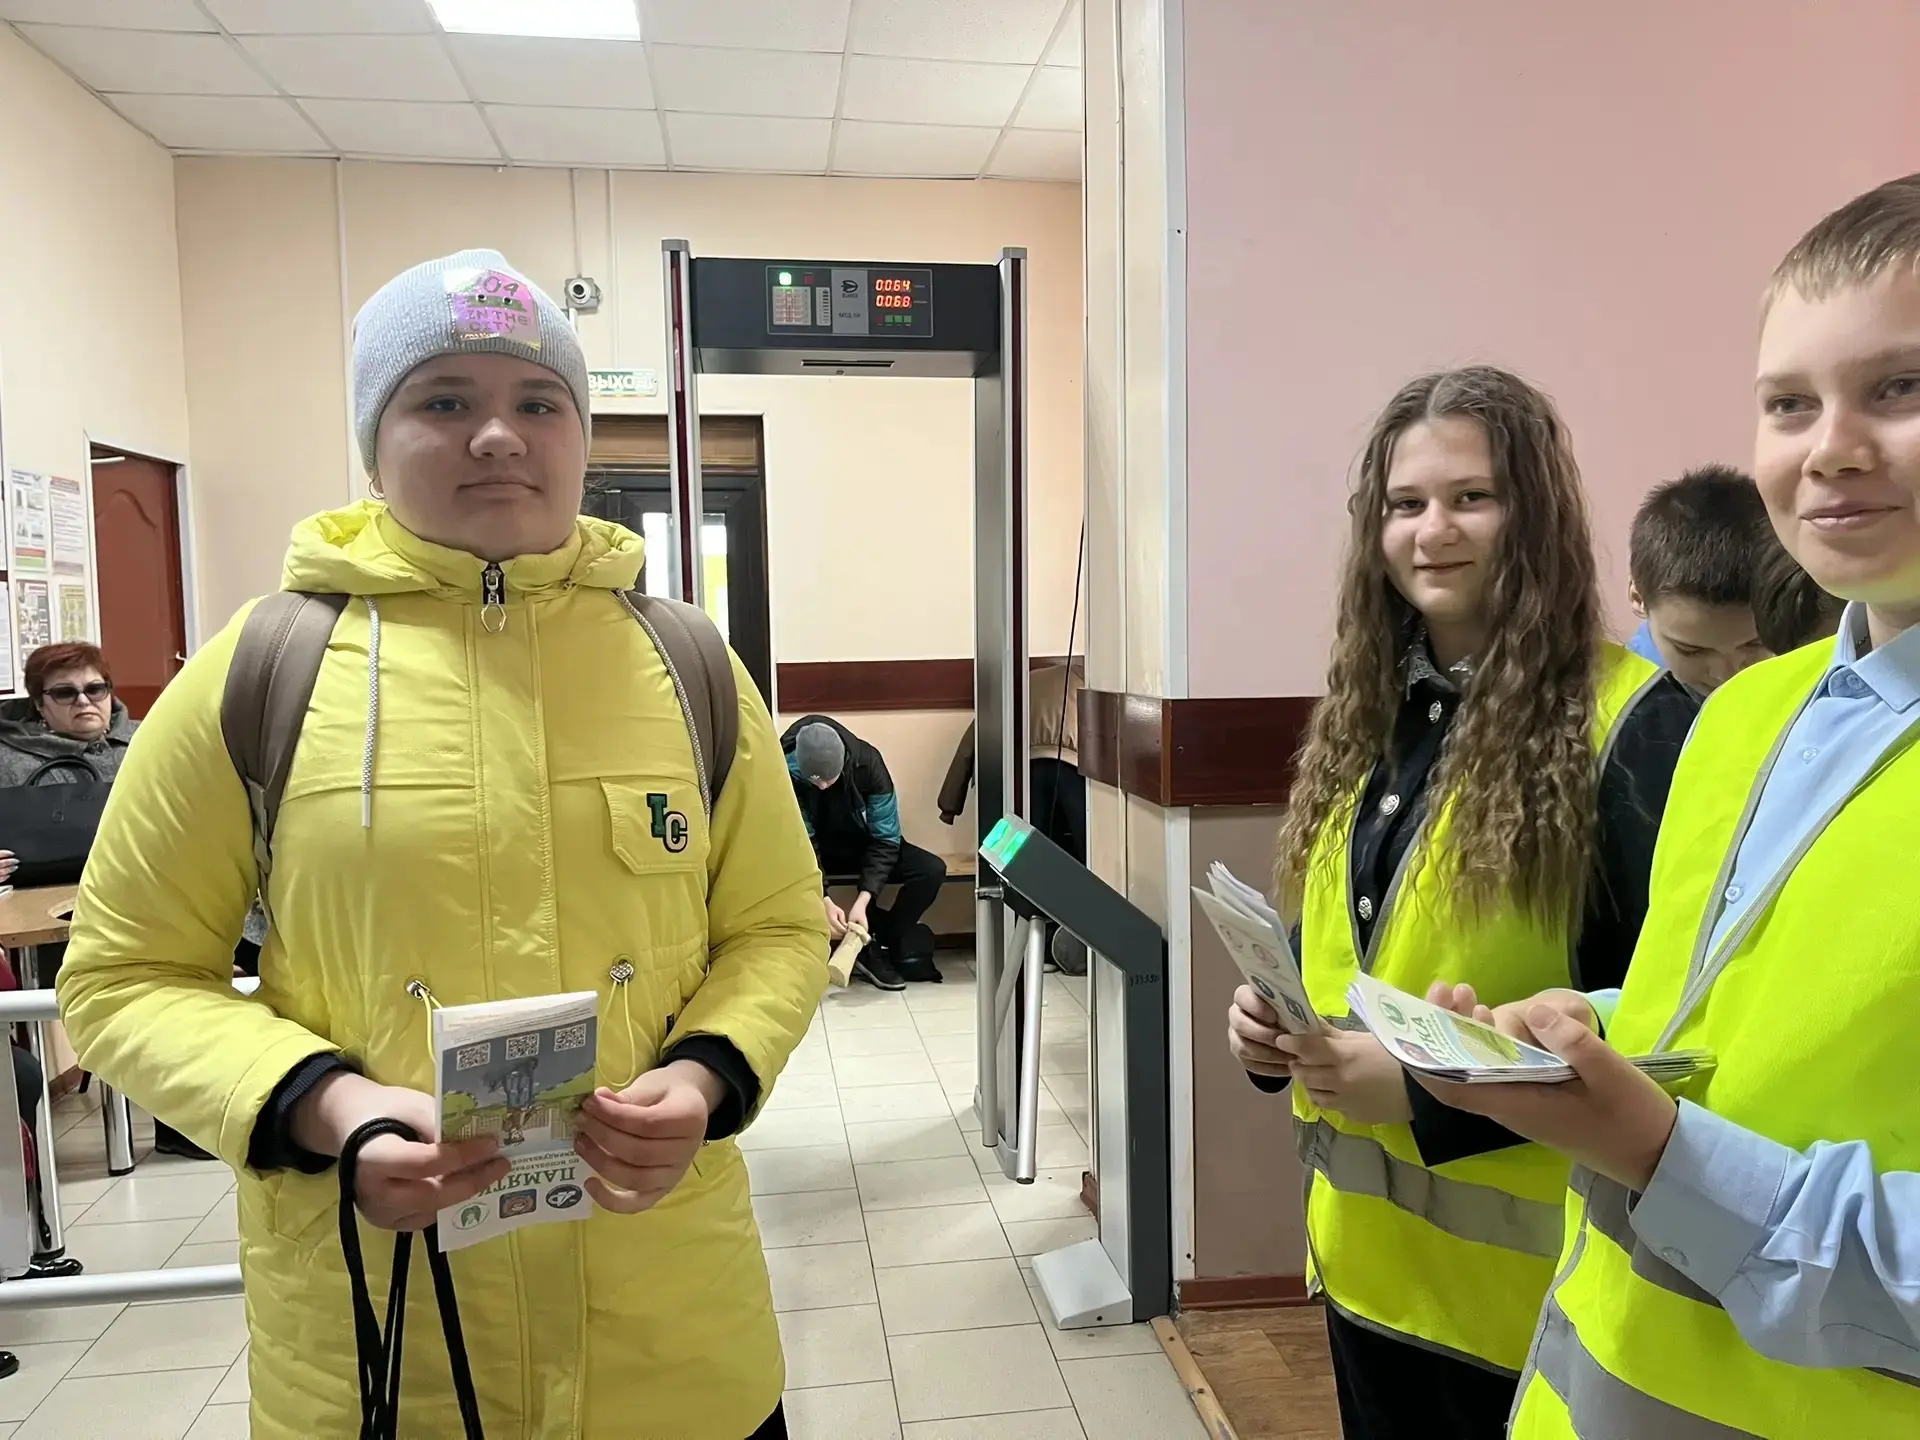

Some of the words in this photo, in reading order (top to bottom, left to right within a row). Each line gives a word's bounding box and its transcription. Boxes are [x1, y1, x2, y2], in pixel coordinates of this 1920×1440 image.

[875, 279, 911, 292] 0064
[876, 294, 911, 308] 0068
[494, 312, 529, 326] THE
